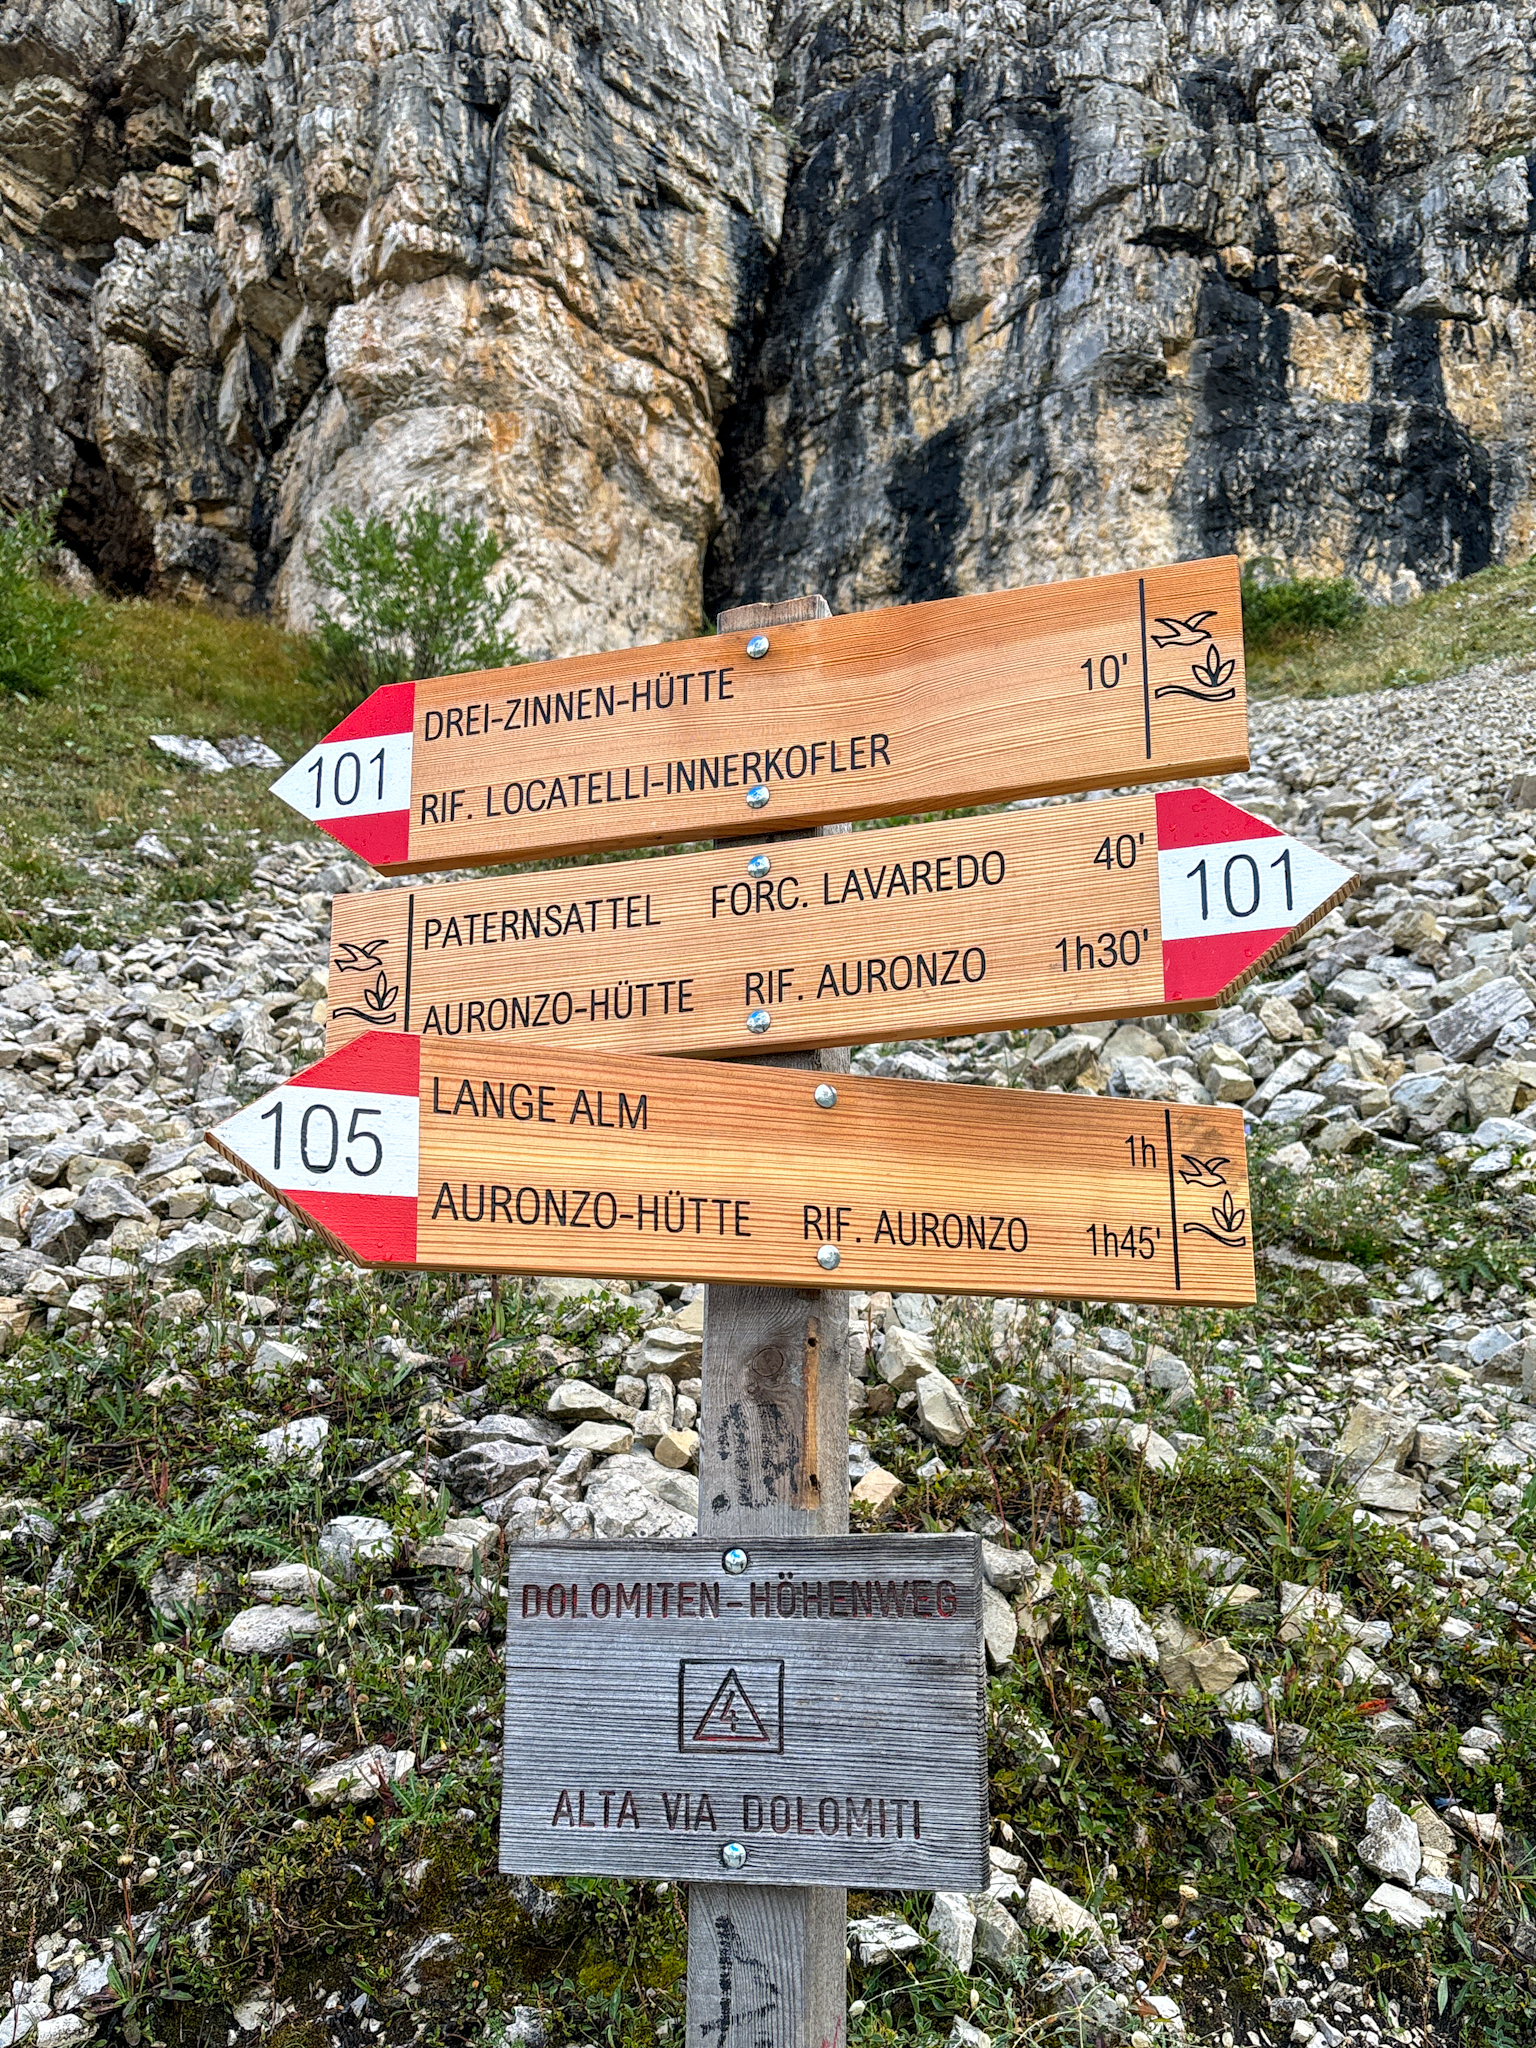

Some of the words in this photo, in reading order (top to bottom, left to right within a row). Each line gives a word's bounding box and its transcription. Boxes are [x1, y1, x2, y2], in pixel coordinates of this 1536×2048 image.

[424, 668, 734, 741] DREI-ZINNEN-HÜTTE
[1081, 653, 1127, 690] 10'
[307, 747, 386, 808] 101
[421, 790, 473, 825] RIF.
[486, 733, 890, 816] LOCATELLI-INNERKOFLER
[424, 895, 660, 950] PATERNSATTEL
[711, 877, 808, 918] FORC.
[823, 850, 1006, 905] LAVAREDO
[1094, 832, 1145, 871] 40'
[1187, 847, 1294, 920] 101
[423, 979, 694, 1035] AURONZO-HÜTTE
[745, 969, 803, 1005] RIF.
[816, 947, 986, 999] AURONZO
[1054, 929, 1148, 973] 1h30'
[432, 1077, 556, 1122] LANGE
[570, 1090, 648, 1130] ALM
[261, 1102, 382, 1176] 105
[1125, 1135, 1156, 1168] 1h
[432, 1182, 751, 1237] AURONZO-HÜTTE
[803, 1205, 861, 1243] RIF.
[874, 1210, 1027, 1253] AURONZO
[1086, 1223, 1161, 1259] 1h45'
[522, 1571, 957, 1619] DOLOMITEN-HÖHENWEG
[719, 1690, 739, 1732] 4
[551, 1789, 640, 1830] ALTA
[662, 1792, 717, 1832] VIA
[743, 1795, 921, 1839] DOLOMITI
